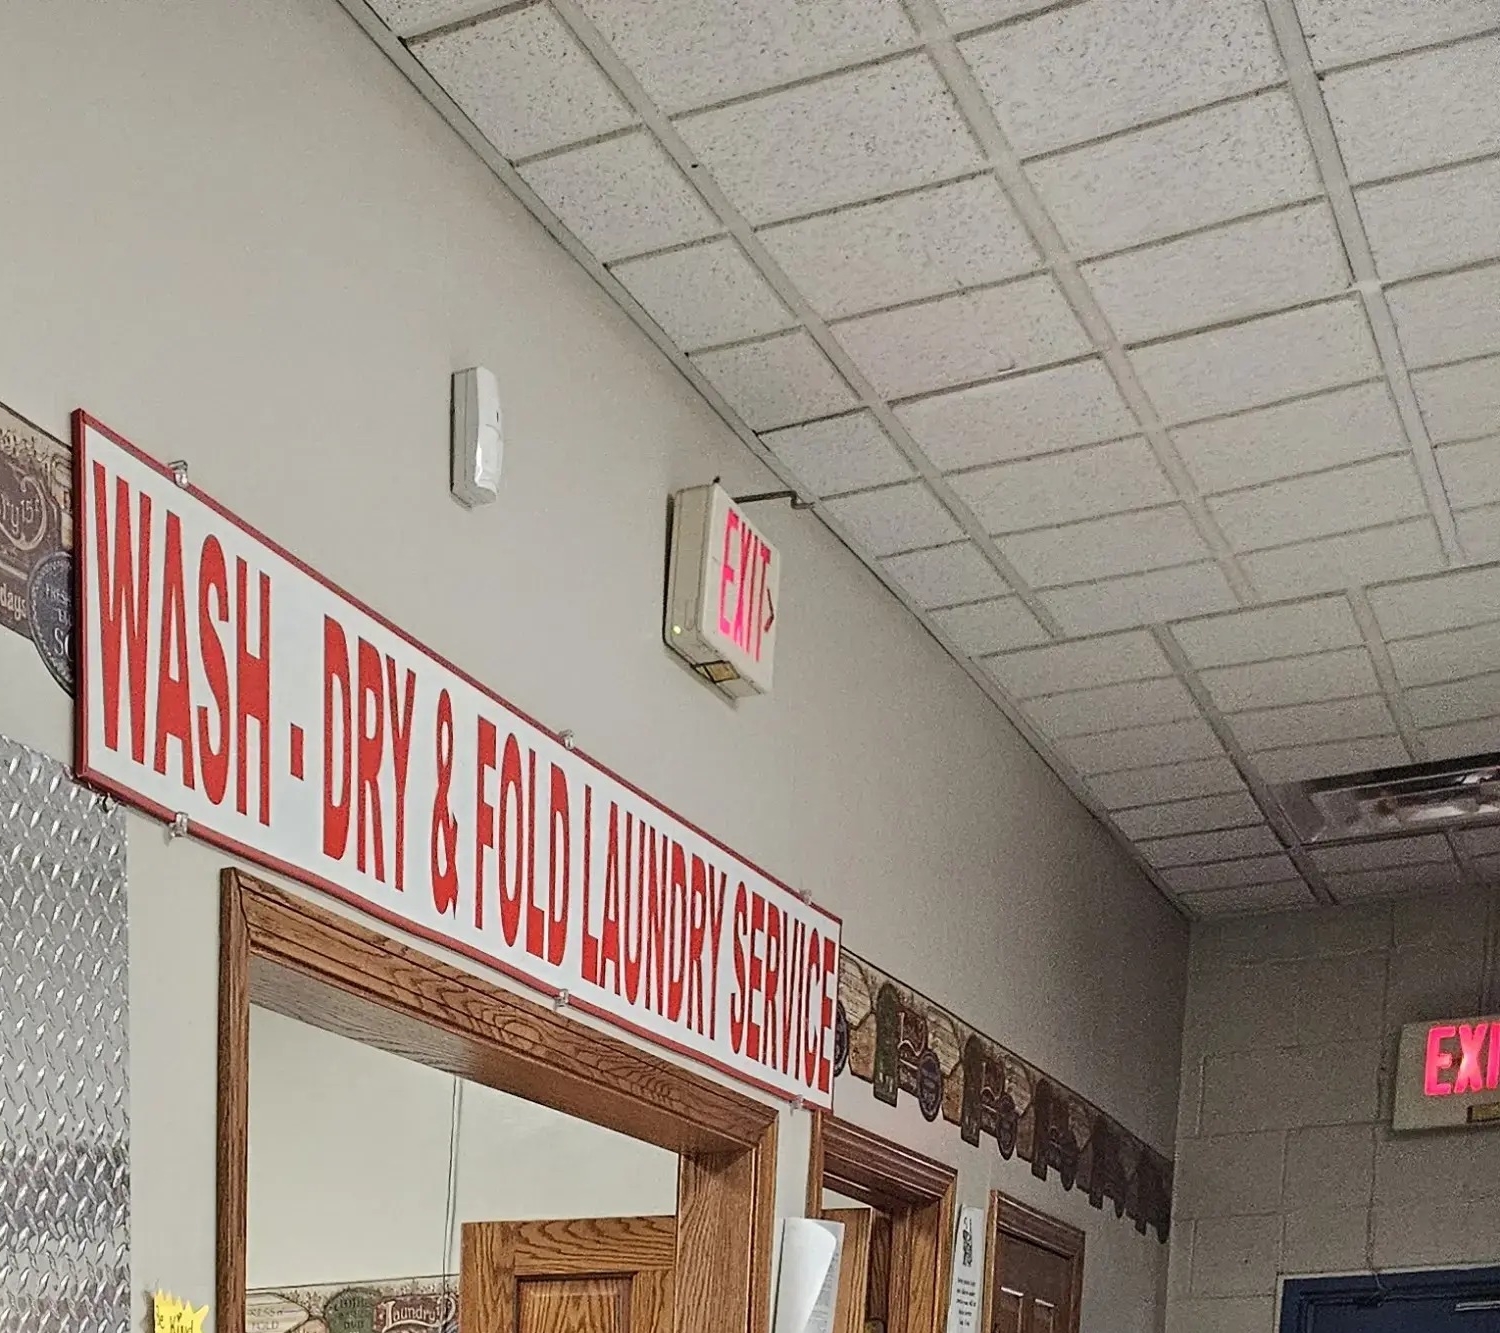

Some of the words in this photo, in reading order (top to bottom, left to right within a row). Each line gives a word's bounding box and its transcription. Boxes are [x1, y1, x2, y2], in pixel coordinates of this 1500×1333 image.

[93, 459, 271, 827] WASH
[322, 613, 417, 893] DRY
[430, 688, 458, 919] &
[474, 713, 571, 967] FOLD
[580, 784, 727, 1042] LAUNDRY
[730, 880, 837, 1095] SERVICE
[720, 506, 772, 663] EXIT
